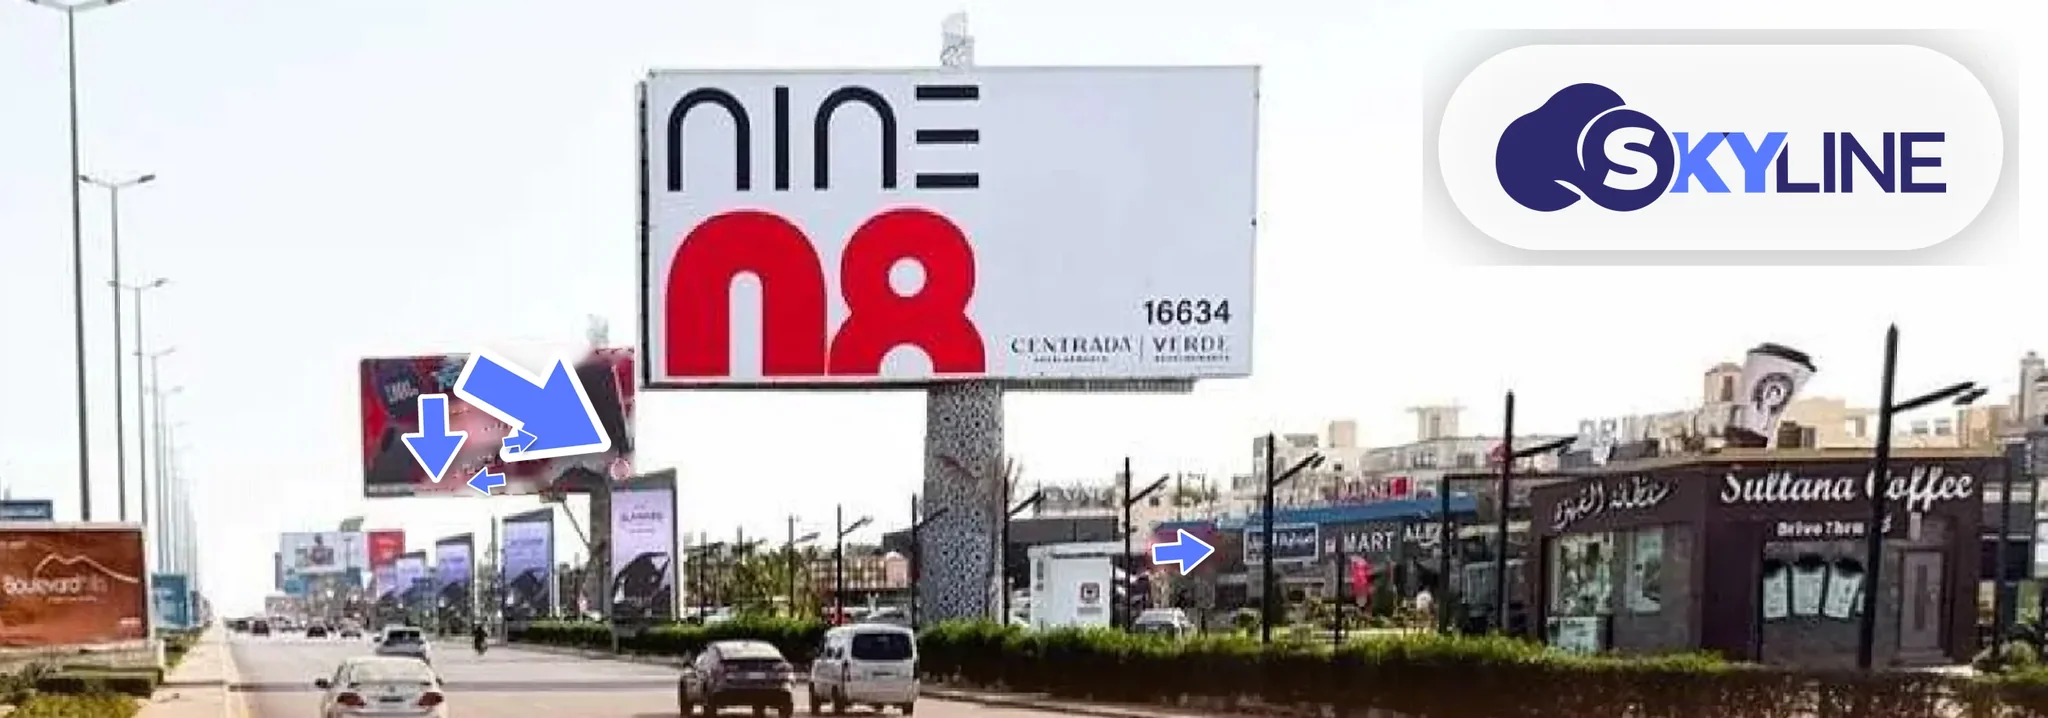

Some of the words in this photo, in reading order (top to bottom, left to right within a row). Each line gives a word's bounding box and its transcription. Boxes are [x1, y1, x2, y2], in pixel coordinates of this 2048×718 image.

[1145, 300, 1231, 325] 16634
[1011, 336, 1132, 353] CENTRADA
[1153, 336, 1228, 352] VERDE
[1721, 470, 1856, 503] Sultana
